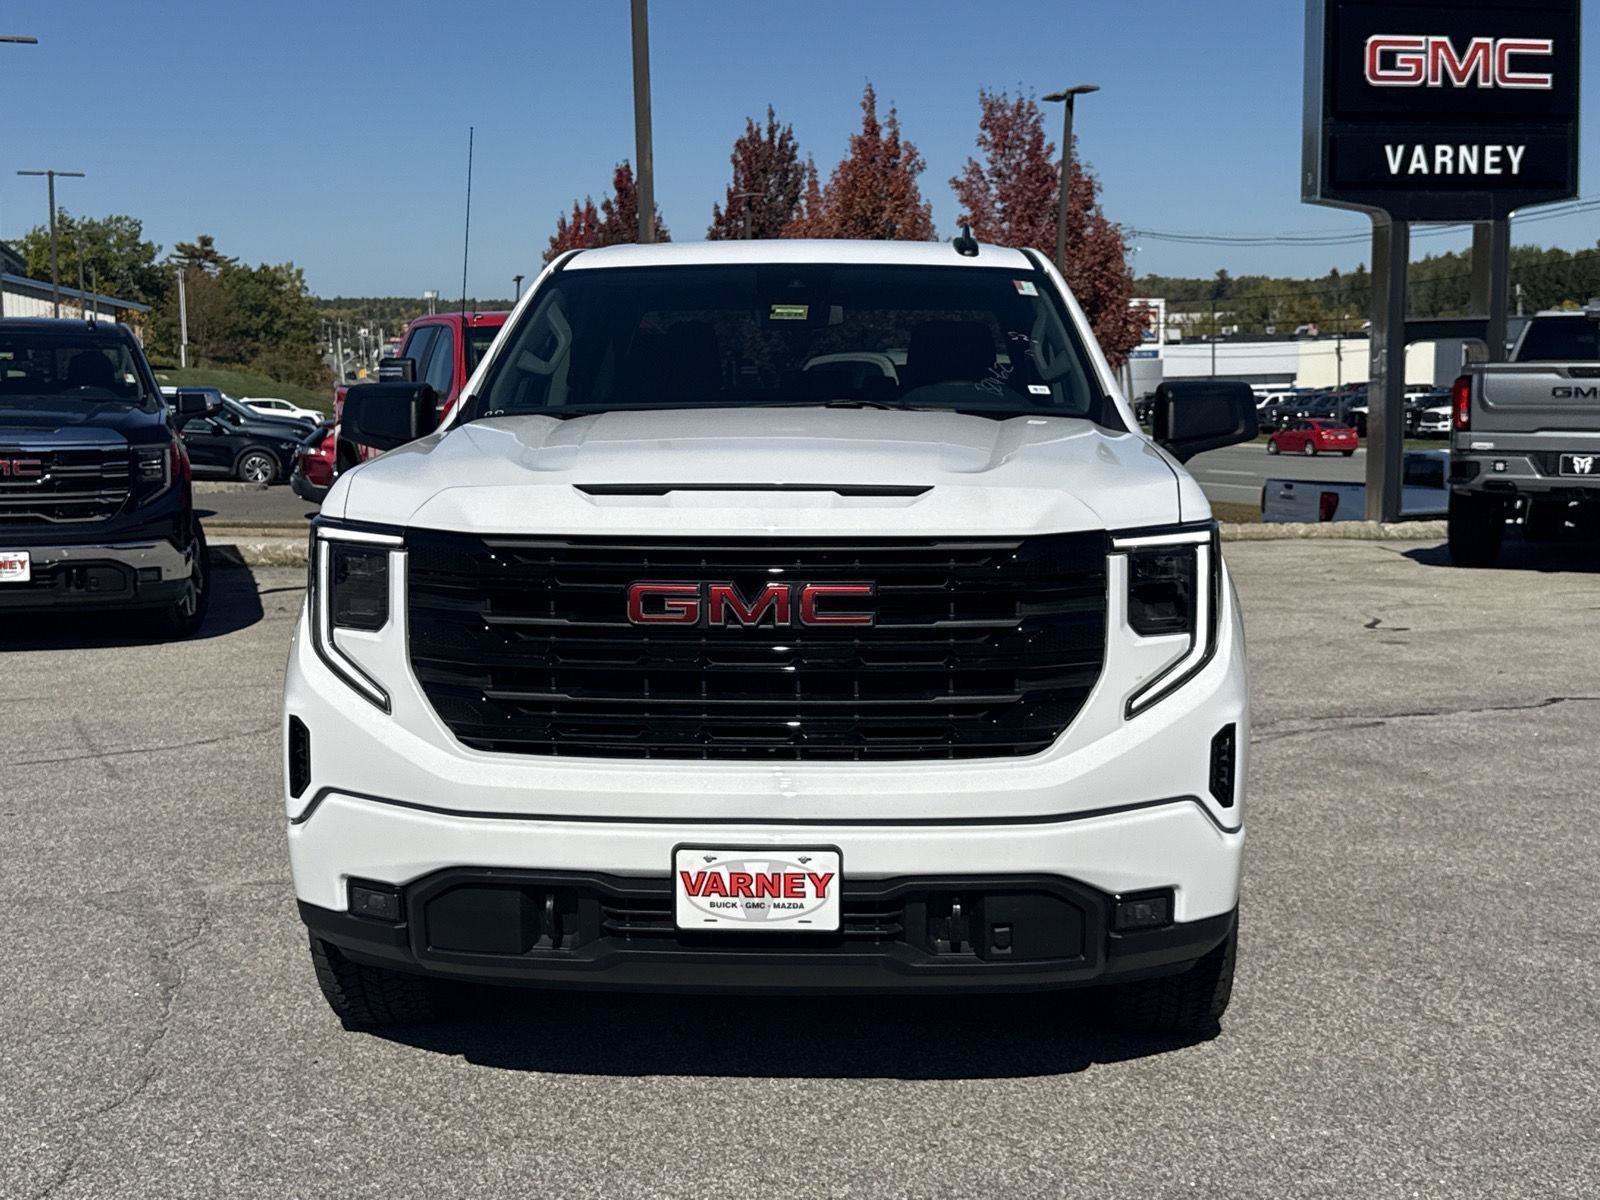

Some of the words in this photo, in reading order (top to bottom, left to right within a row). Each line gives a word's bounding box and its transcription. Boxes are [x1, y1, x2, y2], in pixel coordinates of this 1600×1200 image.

[1365, 34, 1553, 89] GMC
[1384, 144, 1526, 175] VARNEY
[1551, 386, 1600, 400] GM
[627, 582, 875, 627] GMC
[679, 870, 835, 899] VARNEY
[709, 901, 738, 909] BUICK
[745, 902, 766, 910] GMC
[773, 902, 805, 910] MAZDA
